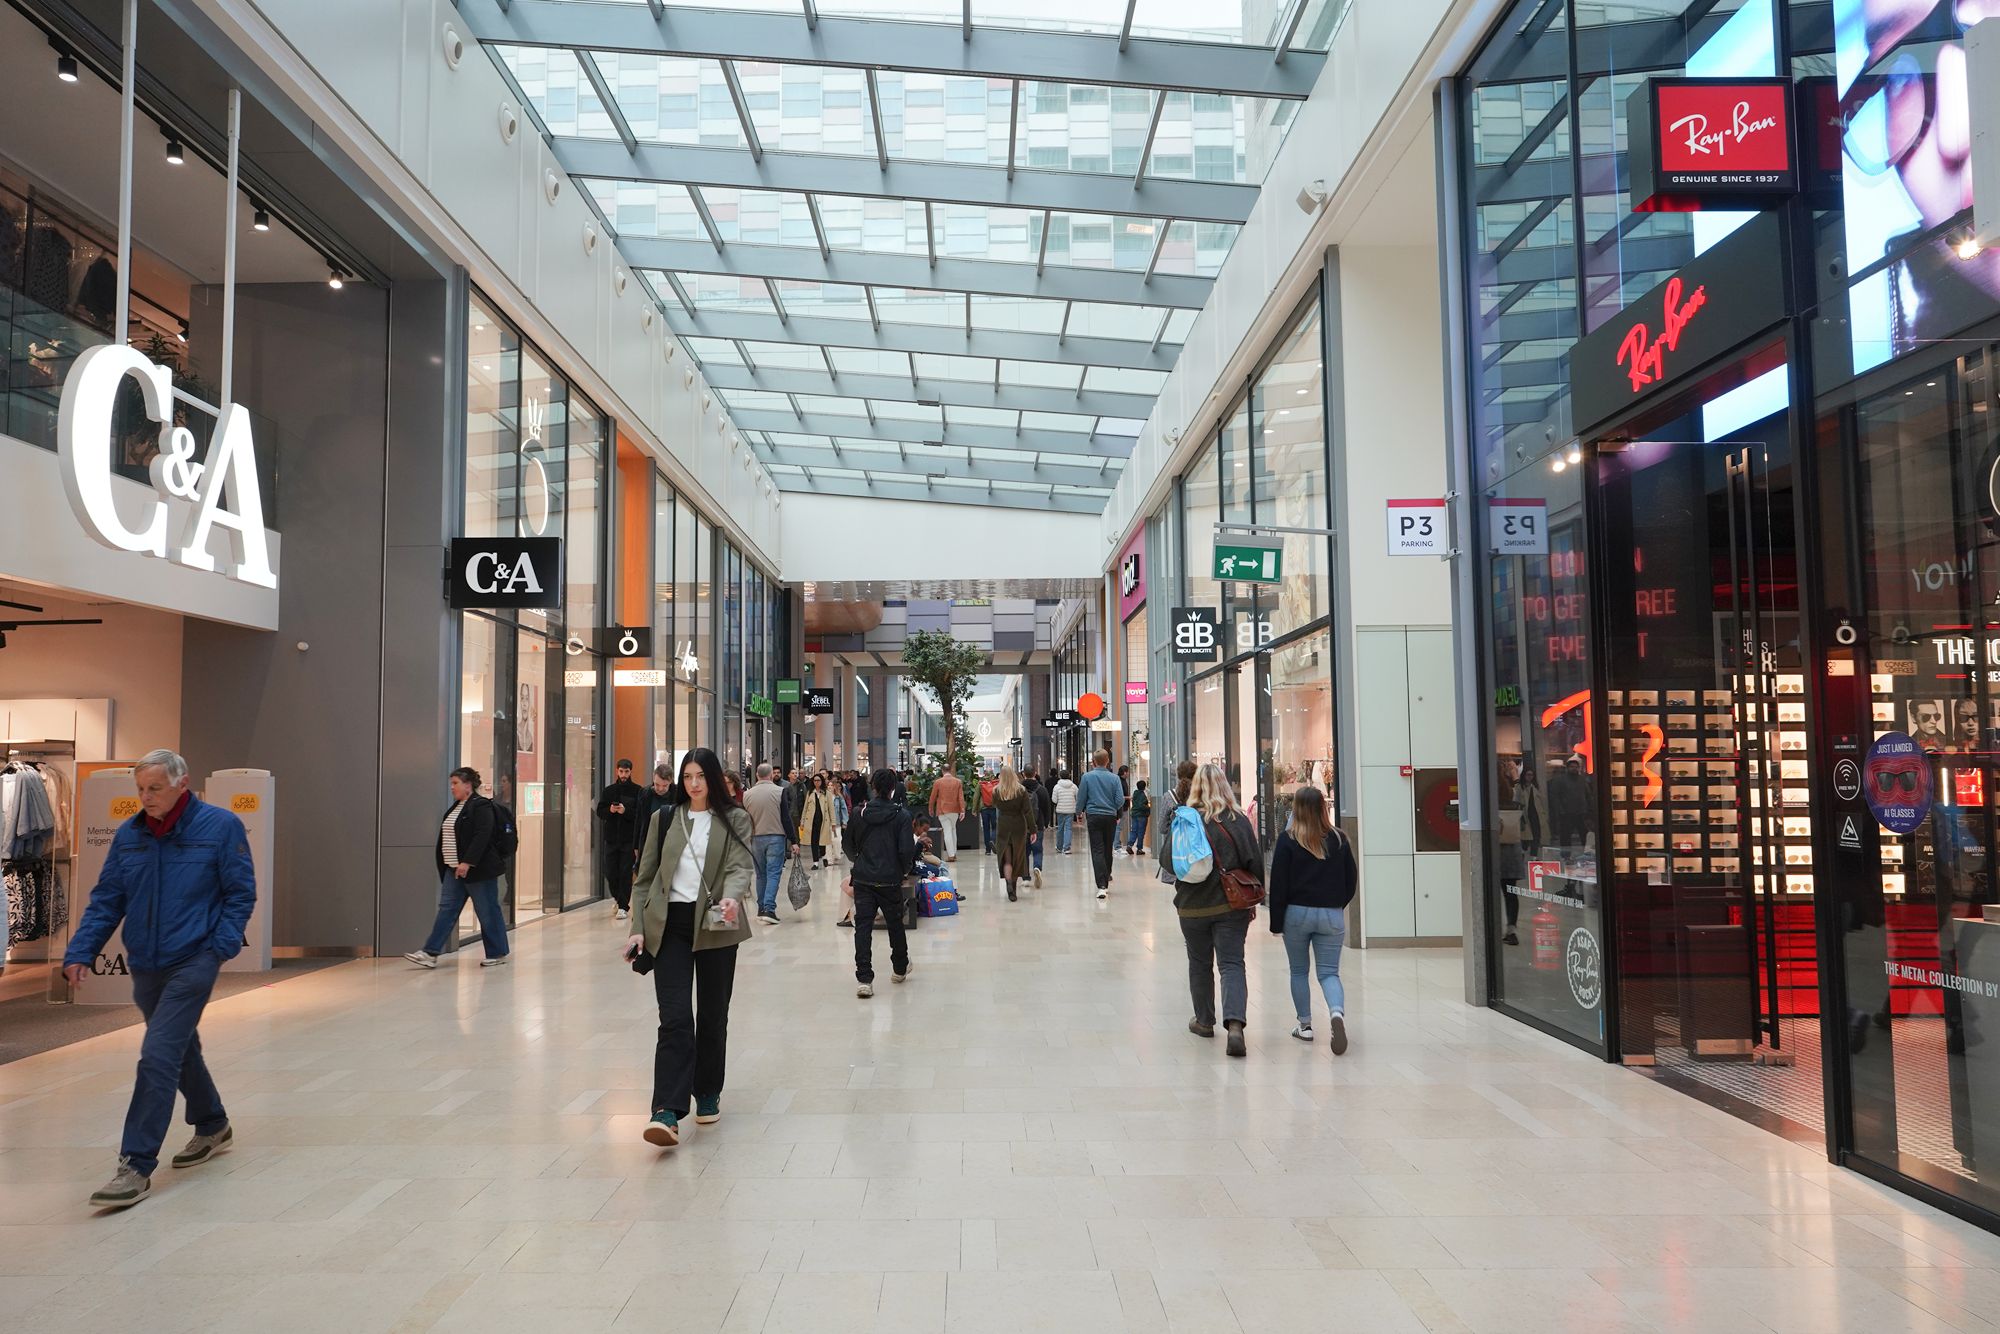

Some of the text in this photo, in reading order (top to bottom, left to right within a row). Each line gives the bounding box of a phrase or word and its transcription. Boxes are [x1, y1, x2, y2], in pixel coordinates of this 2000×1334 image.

[60, 344, 277, 589] C&A
[465, 552, 543, 593] C&A
[1548, 635, 1586, 661] EYE
[1932, 638, 1976, 665] THE
[1877, 742, 1913, 754] JUST LANDED
[120, 801, 138, 809] C&A
[1891, 808, 1915, 818] GLASSES
[87, 827, 115, 835] Membe
[91, 953, 129, 976] C&A
[1884, 961, 1998, 998] THE METAL COLLECTION BY
